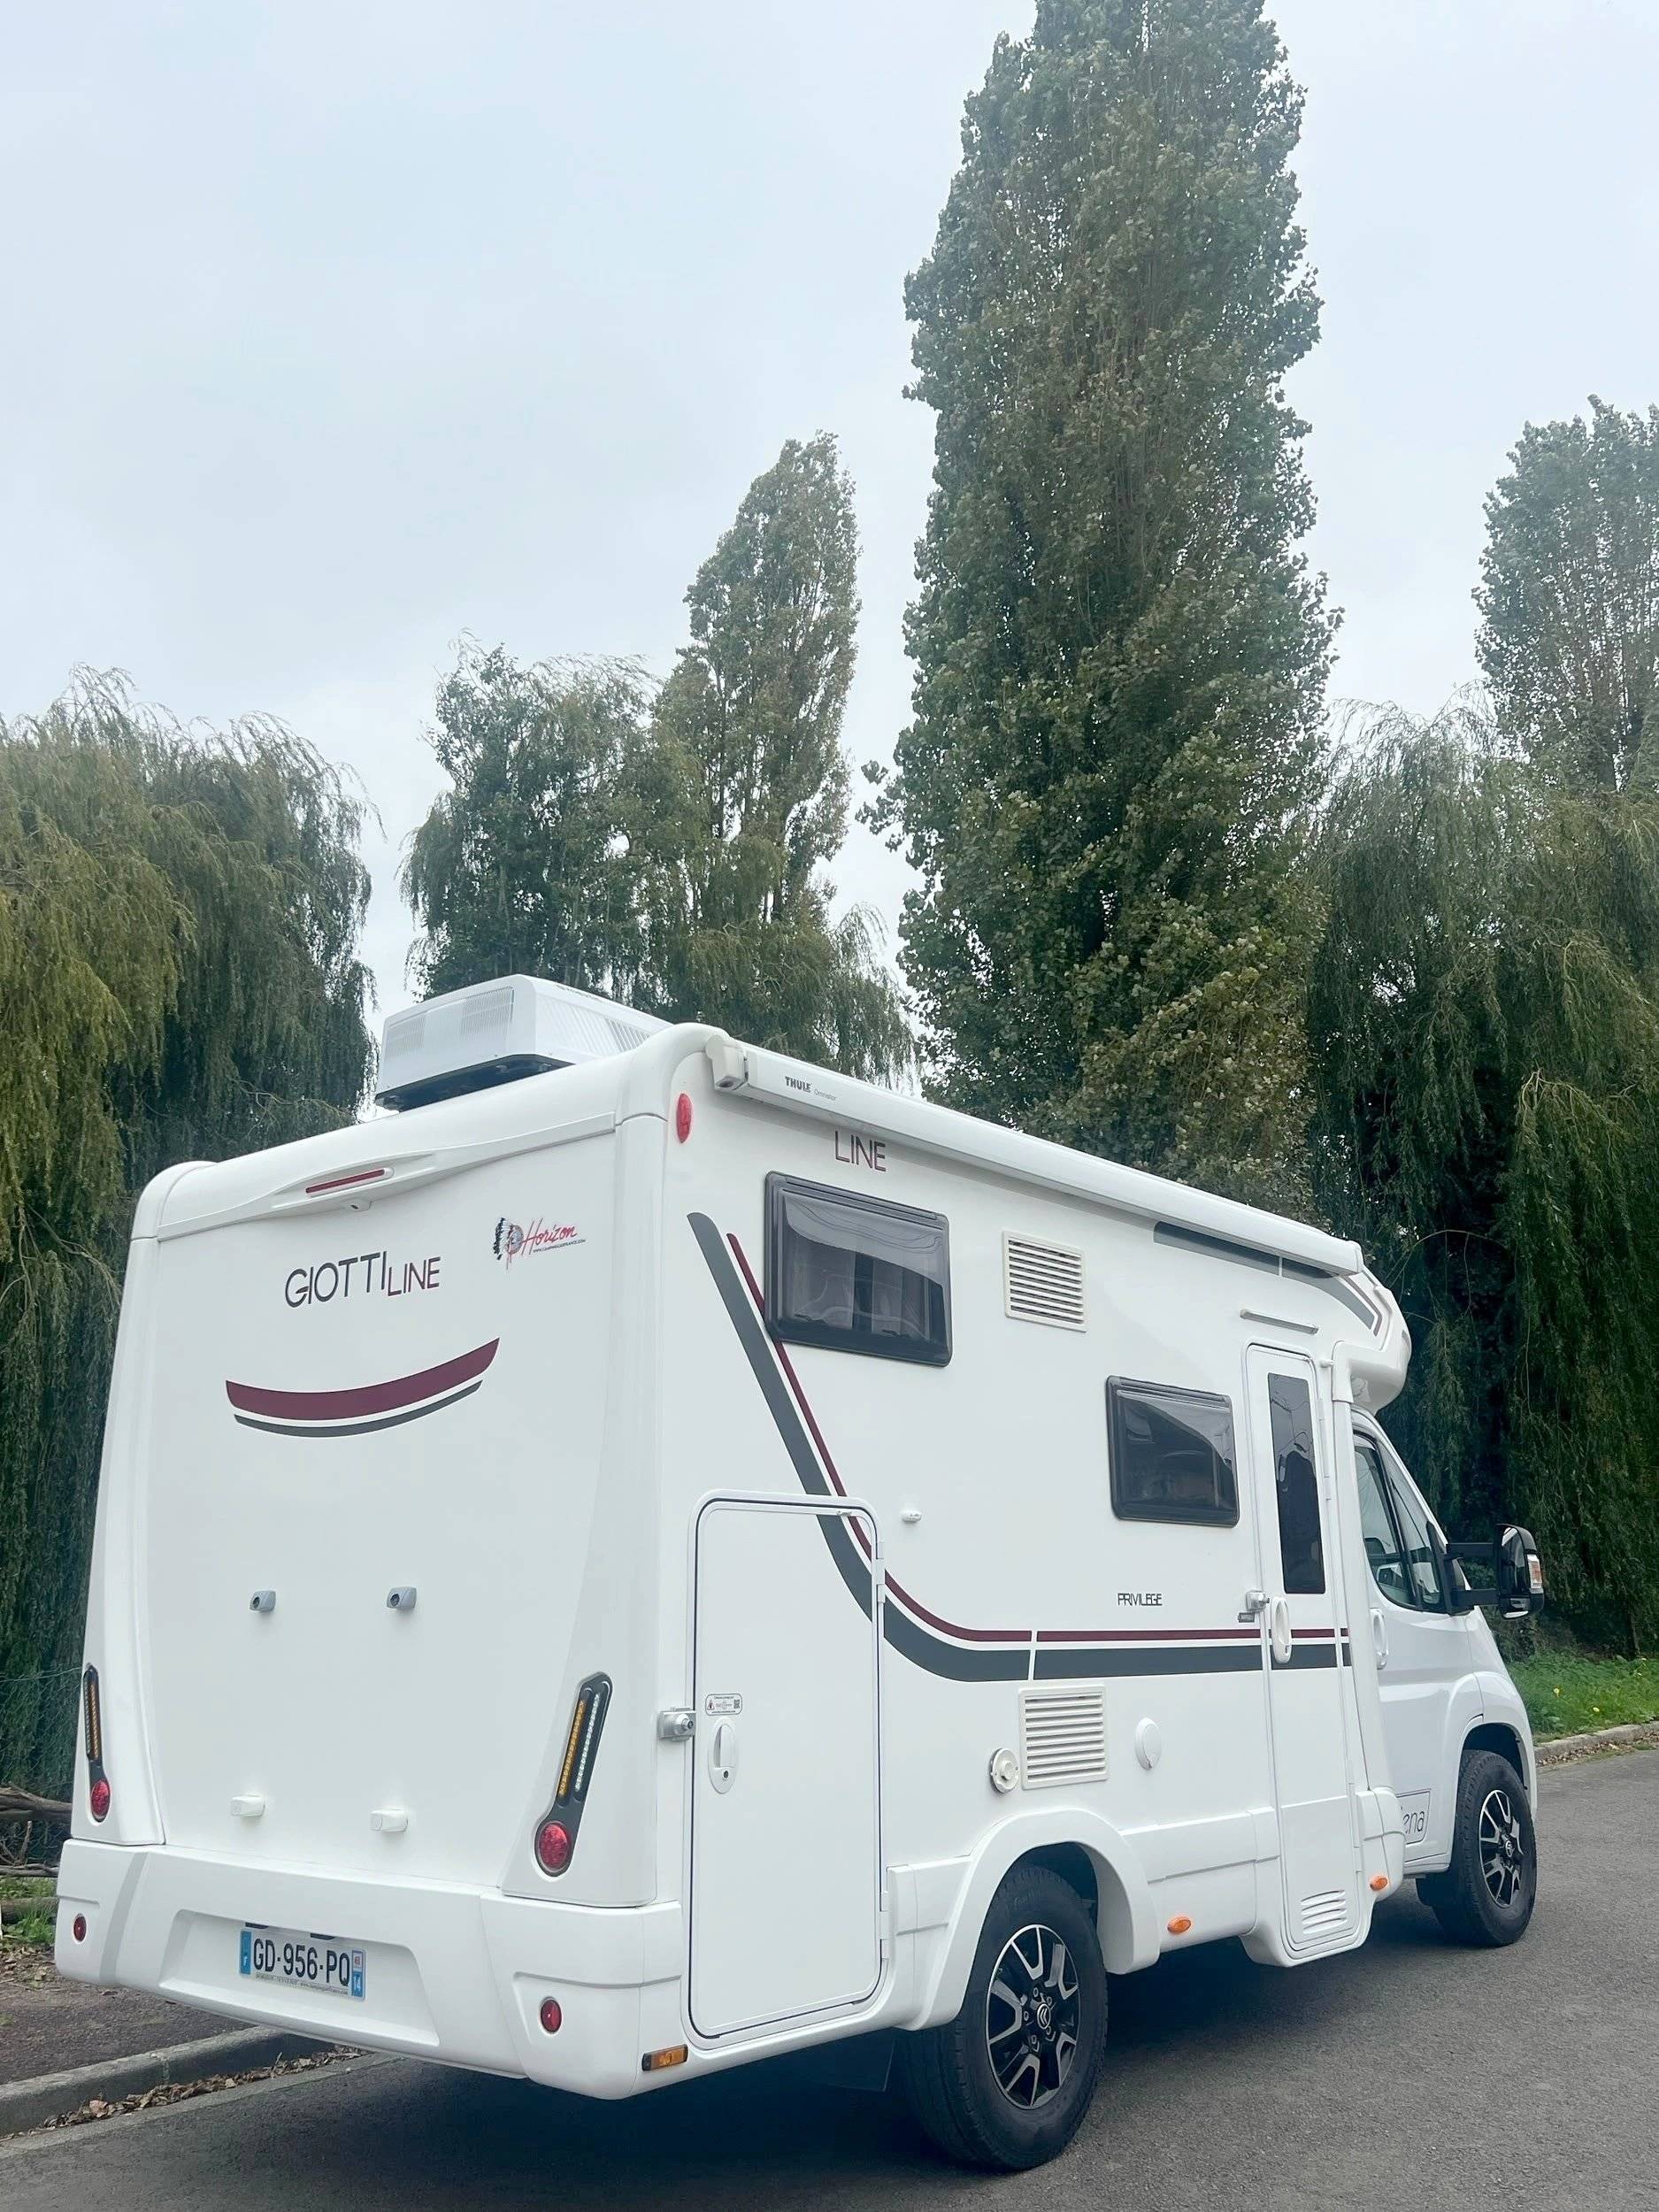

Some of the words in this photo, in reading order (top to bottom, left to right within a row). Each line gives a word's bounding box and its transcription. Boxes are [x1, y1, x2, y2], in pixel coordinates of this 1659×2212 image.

[785, 1075, 811, 1094] THULE
[834, 1130, 887, 1172] LINE
[520, 1217, 578, 1256] Horizon
[1118, 1592, 1163, 1606] PRIVILEGE
